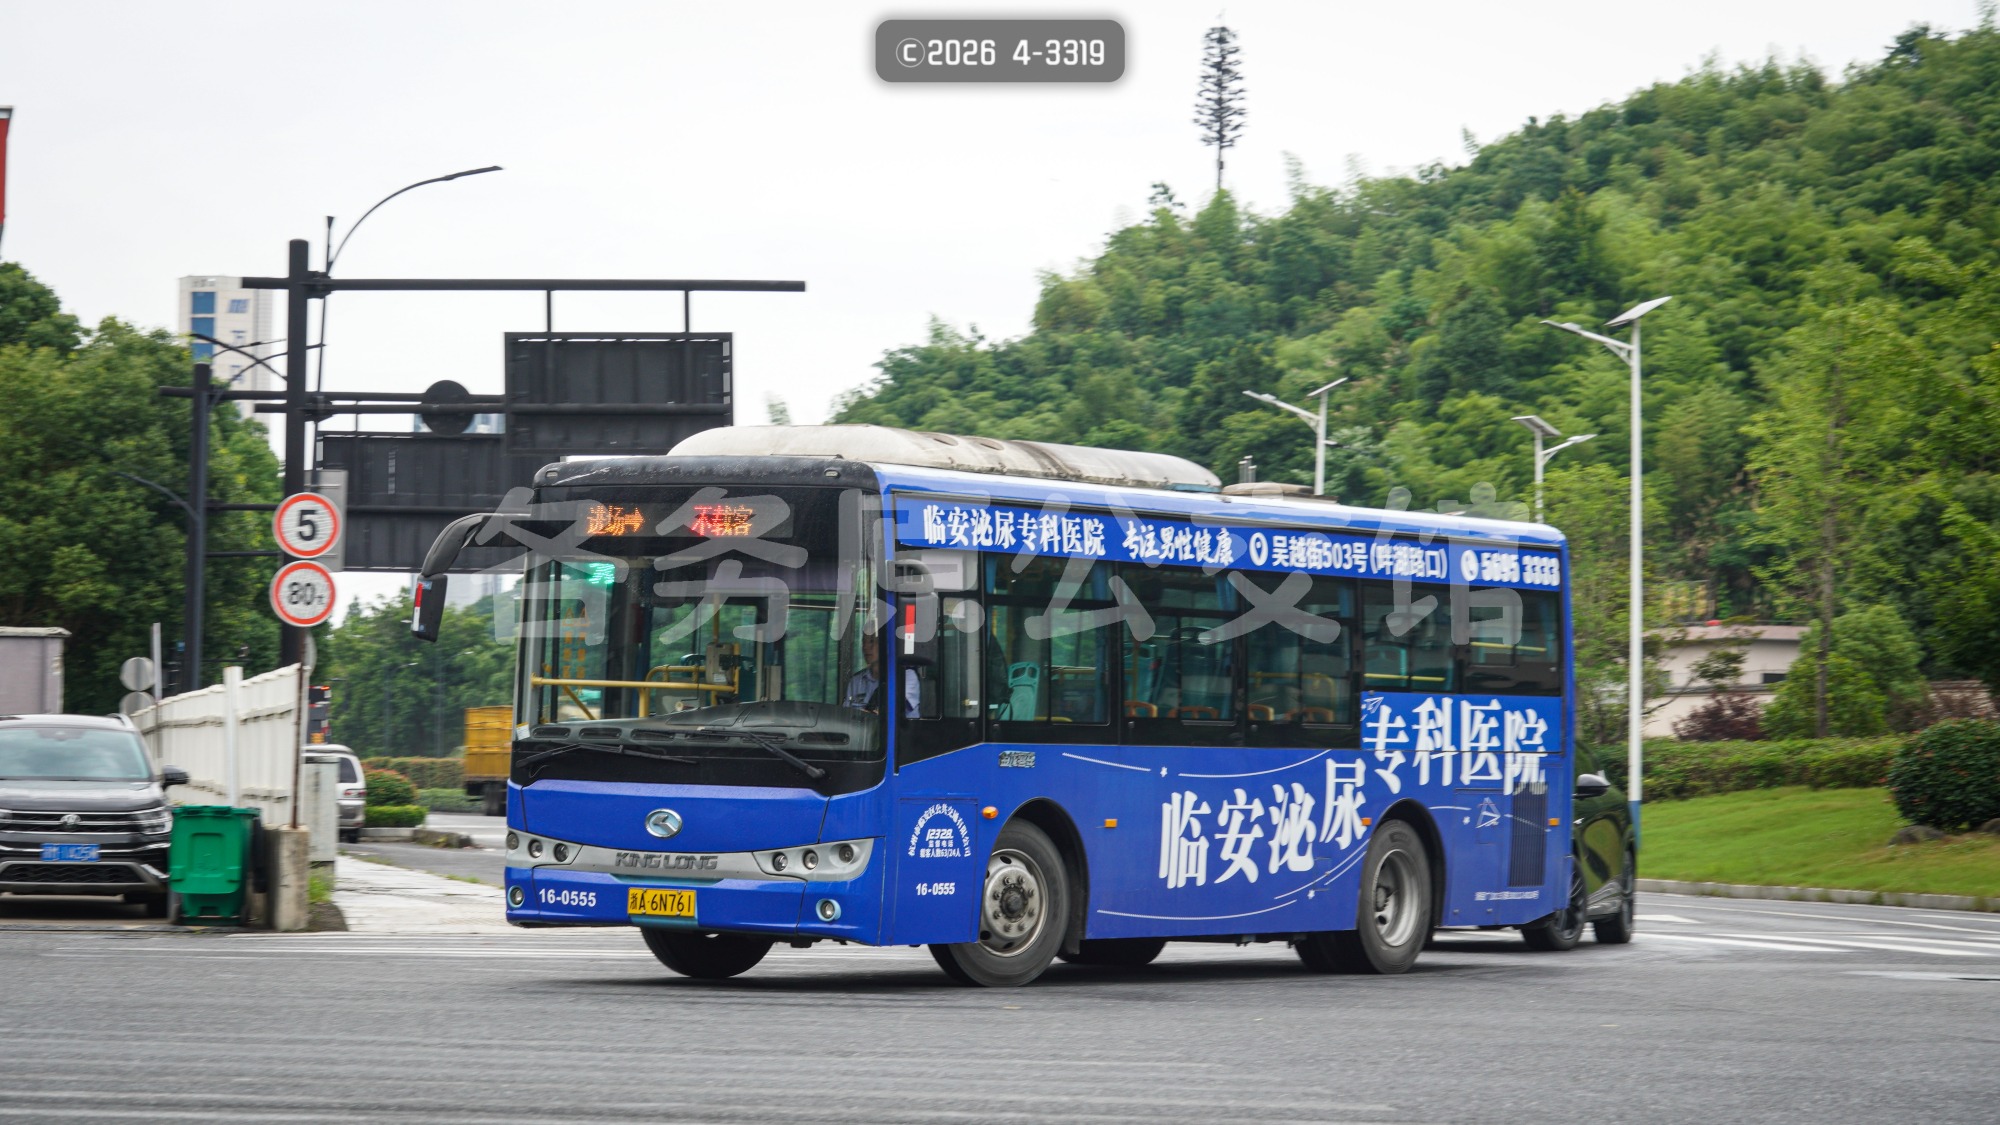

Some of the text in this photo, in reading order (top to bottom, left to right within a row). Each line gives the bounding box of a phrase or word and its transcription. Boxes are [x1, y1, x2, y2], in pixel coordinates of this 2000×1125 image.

[298, 509, 317, 541] 5
[586, 504, 753, 536] 进场 不载客
[923, 504, 1105, 555] 临安泌尿专科医院
[1122, 520, 1234, 566] 专注男性健康
[1522, 555, 1561, 587] 3333
[614, 851, 718, 870] KING LONG
[539, 889, 597, 907] 16-0555
[916, 882, 956, 896] 16-0555
